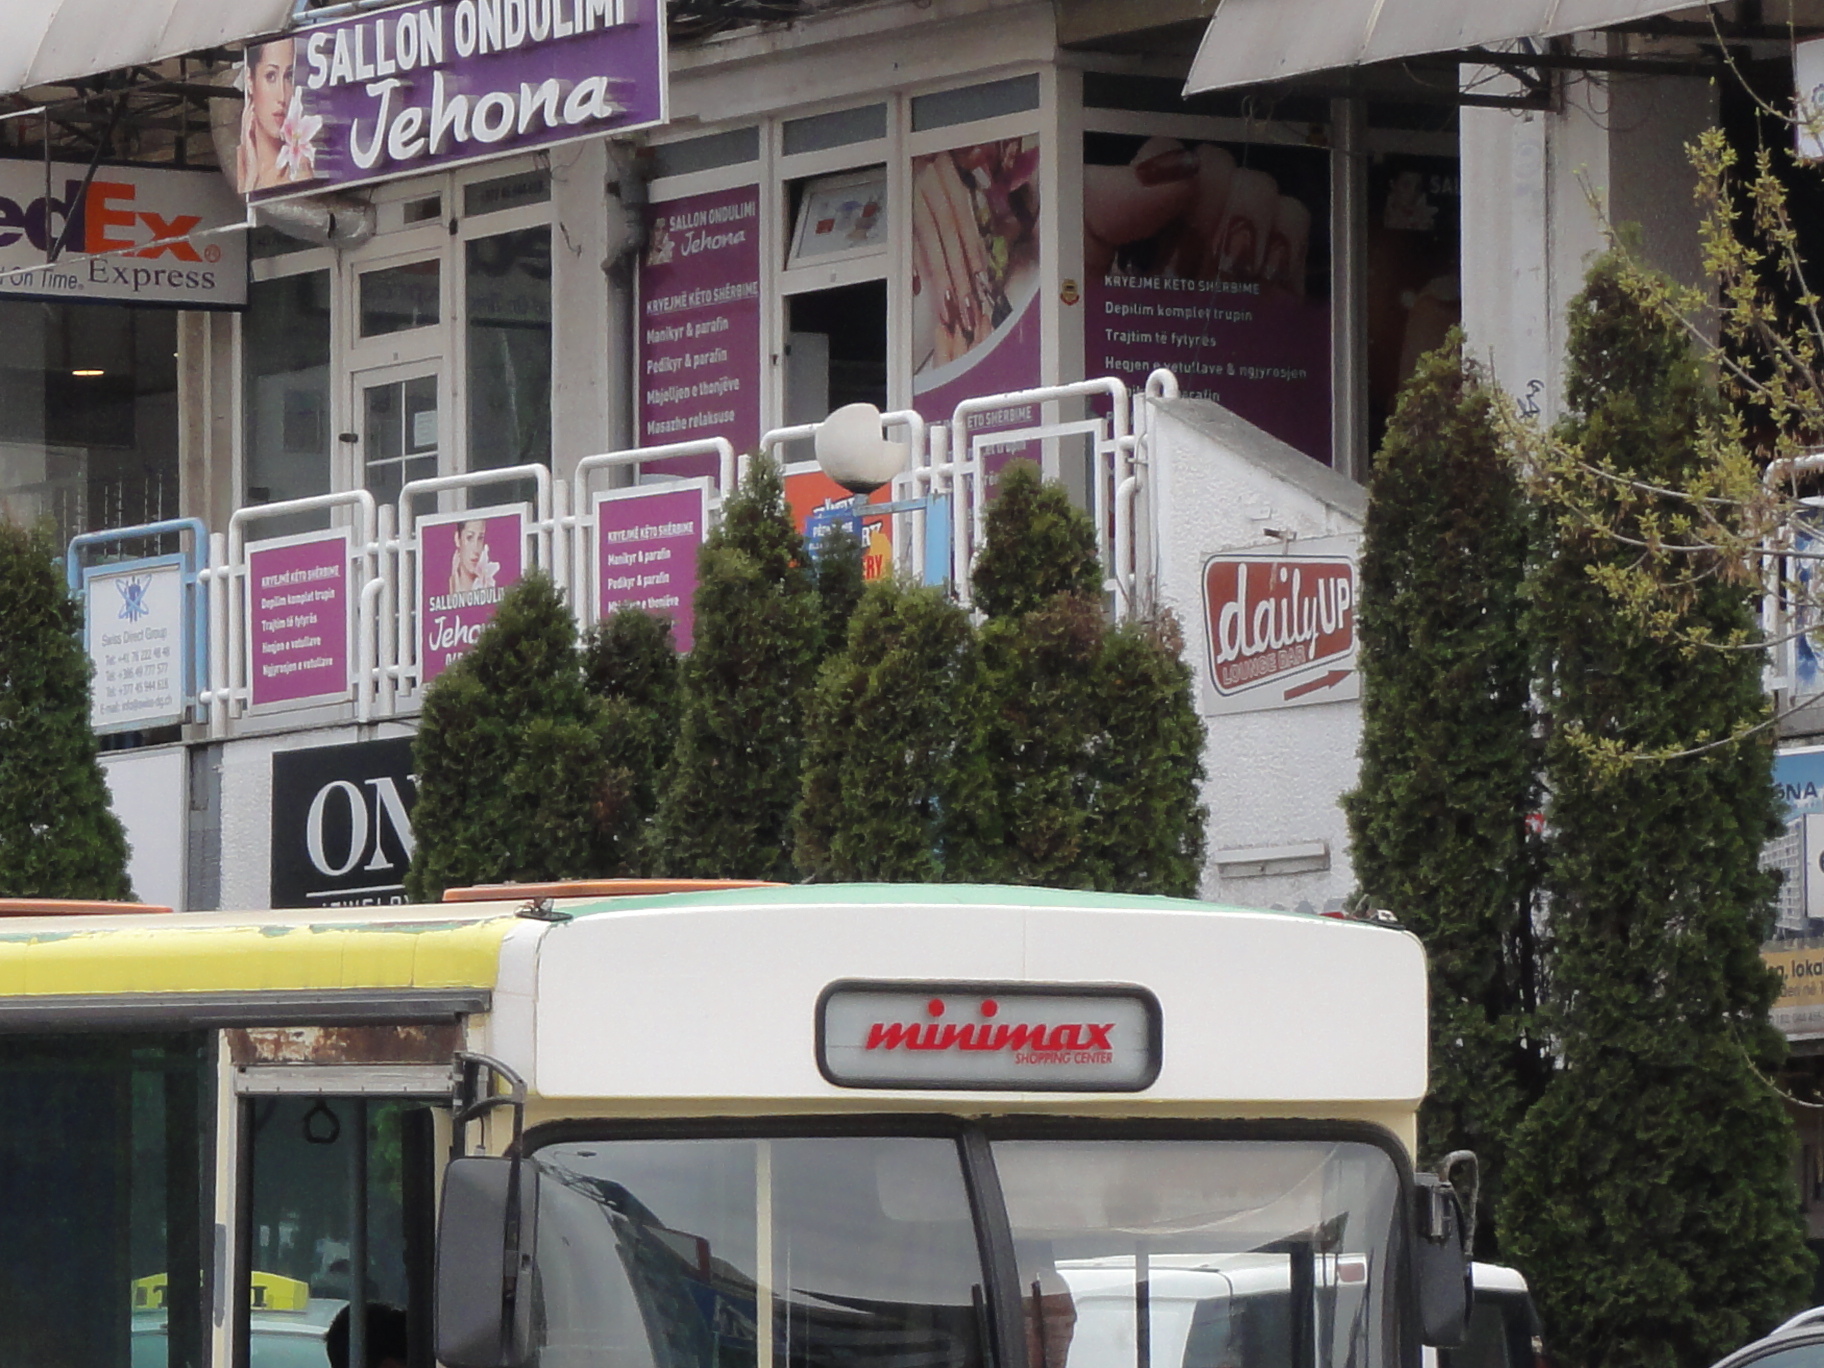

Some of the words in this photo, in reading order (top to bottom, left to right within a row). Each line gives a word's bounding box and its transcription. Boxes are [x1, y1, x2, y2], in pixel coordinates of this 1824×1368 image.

[307, 5, 443, 89] SALLON
[350, 70, 613, 169] Jehona
[669, 211, 707, 232] SALLON
[709, 201, 756, 224] ONDULIMI
[681, 230, 746, 256] Jehona
[88, 258, 215, 291] Express
[1105, 302, 1153, 316] Depilim
[1213, 308, 1253, 322] trupin
[647, 326, 684, 344] Manikyr
[686, 322, 693, 337] &
[695, 316, 729, 338] parafin
[1105, 329, 1151, 344] Trajtim
[647, 357, 683, 374] Pedikyr
[685, 353, 691, 367] &
[693, 348, 727, 369] parafin
[1105, 356, 1149, 372] Heqjen
[647, 416, 687, 435] Masazhe
[688, 410, 735, 428] relaksuse
[429, 592, 465, 612] SALLON
[429, 615, 494, 651] Jeho
[1223, 652, 1277, 685] LOUNGE
[1278, 645, 1306, 669] BAR
[1792, 958, 1824, 977] loka
[866, 998, 1116, 1051] minimax
[1015, 1051, 1070, 1065] SHOPPING
[1074, 1051, 1113, 1065] CENTER
